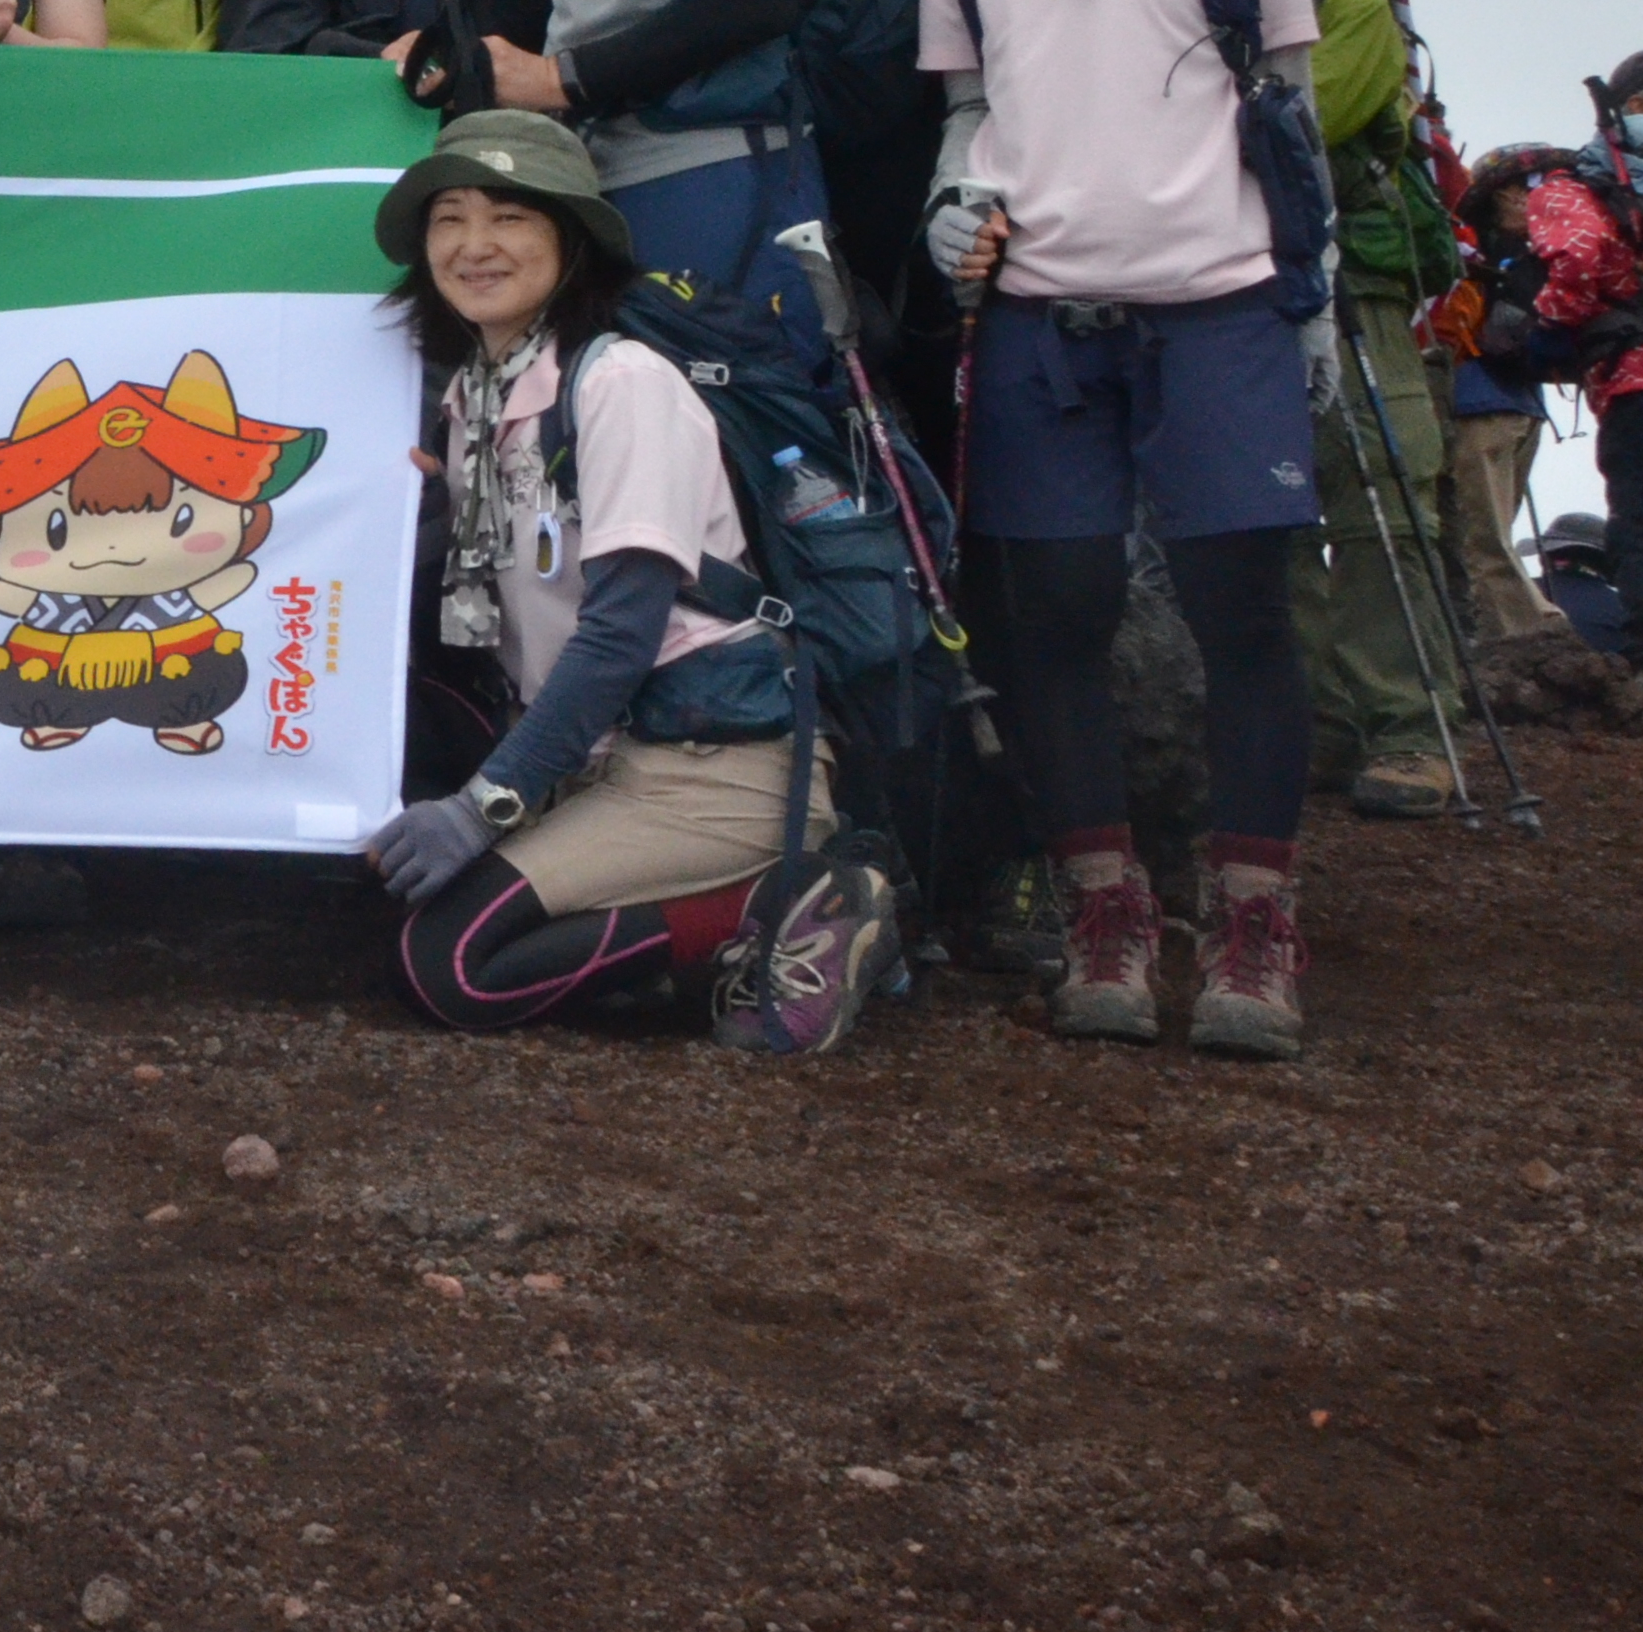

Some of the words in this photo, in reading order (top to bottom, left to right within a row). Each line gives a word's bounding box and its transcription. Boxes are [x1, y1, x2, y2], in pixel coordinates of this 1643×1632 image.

[269, 576, 316, 751] ちゃぐぽん
